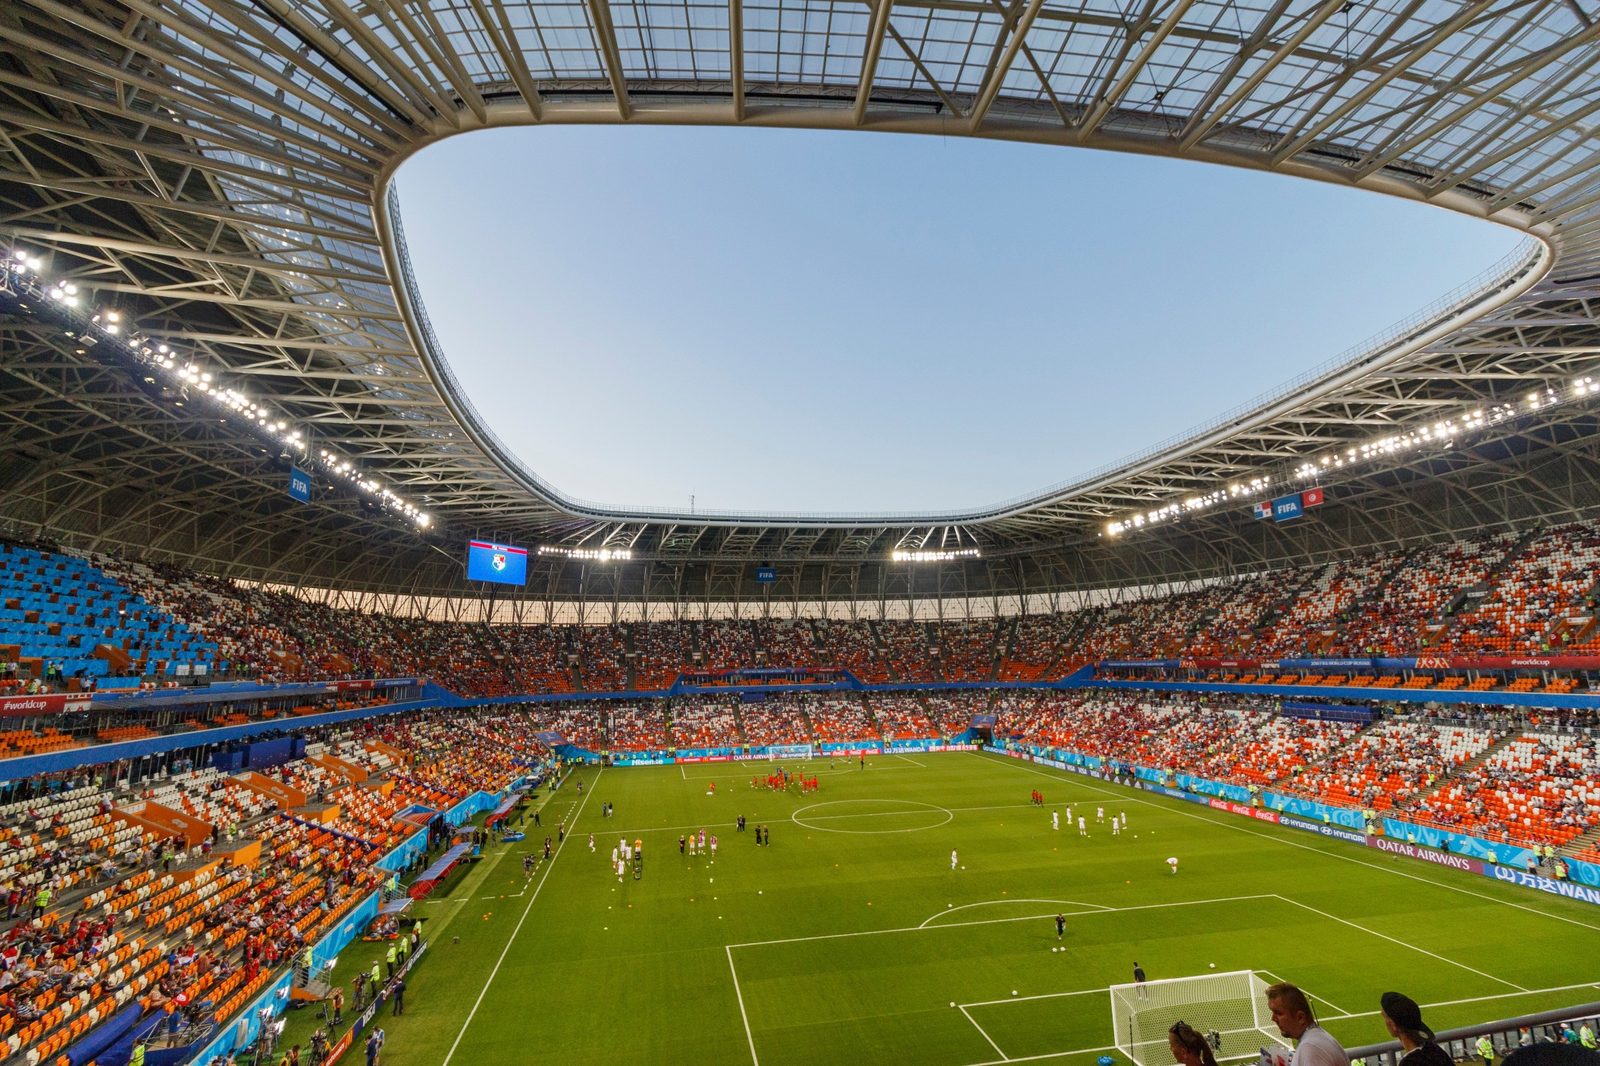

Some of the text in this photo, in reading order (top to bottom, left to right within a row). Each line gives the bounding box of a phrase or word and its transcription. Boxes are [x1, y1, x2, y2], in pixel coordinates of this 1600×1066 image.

[293, 478, 307, 495] FIFA
[1278, 503, 1297, 514] FIFA
[1511, 659, 1550, 667] #worldcup
[4, 700, 47, 710] #worldcup
[1290, 818, 1319, 832] HYUNDAI
[1333, 830, 1366, 843] HYUNDAI
[1376, 838, 1470, 870] QATAR AIRWAYS
[362, 1003, 376, 1027] VISA
